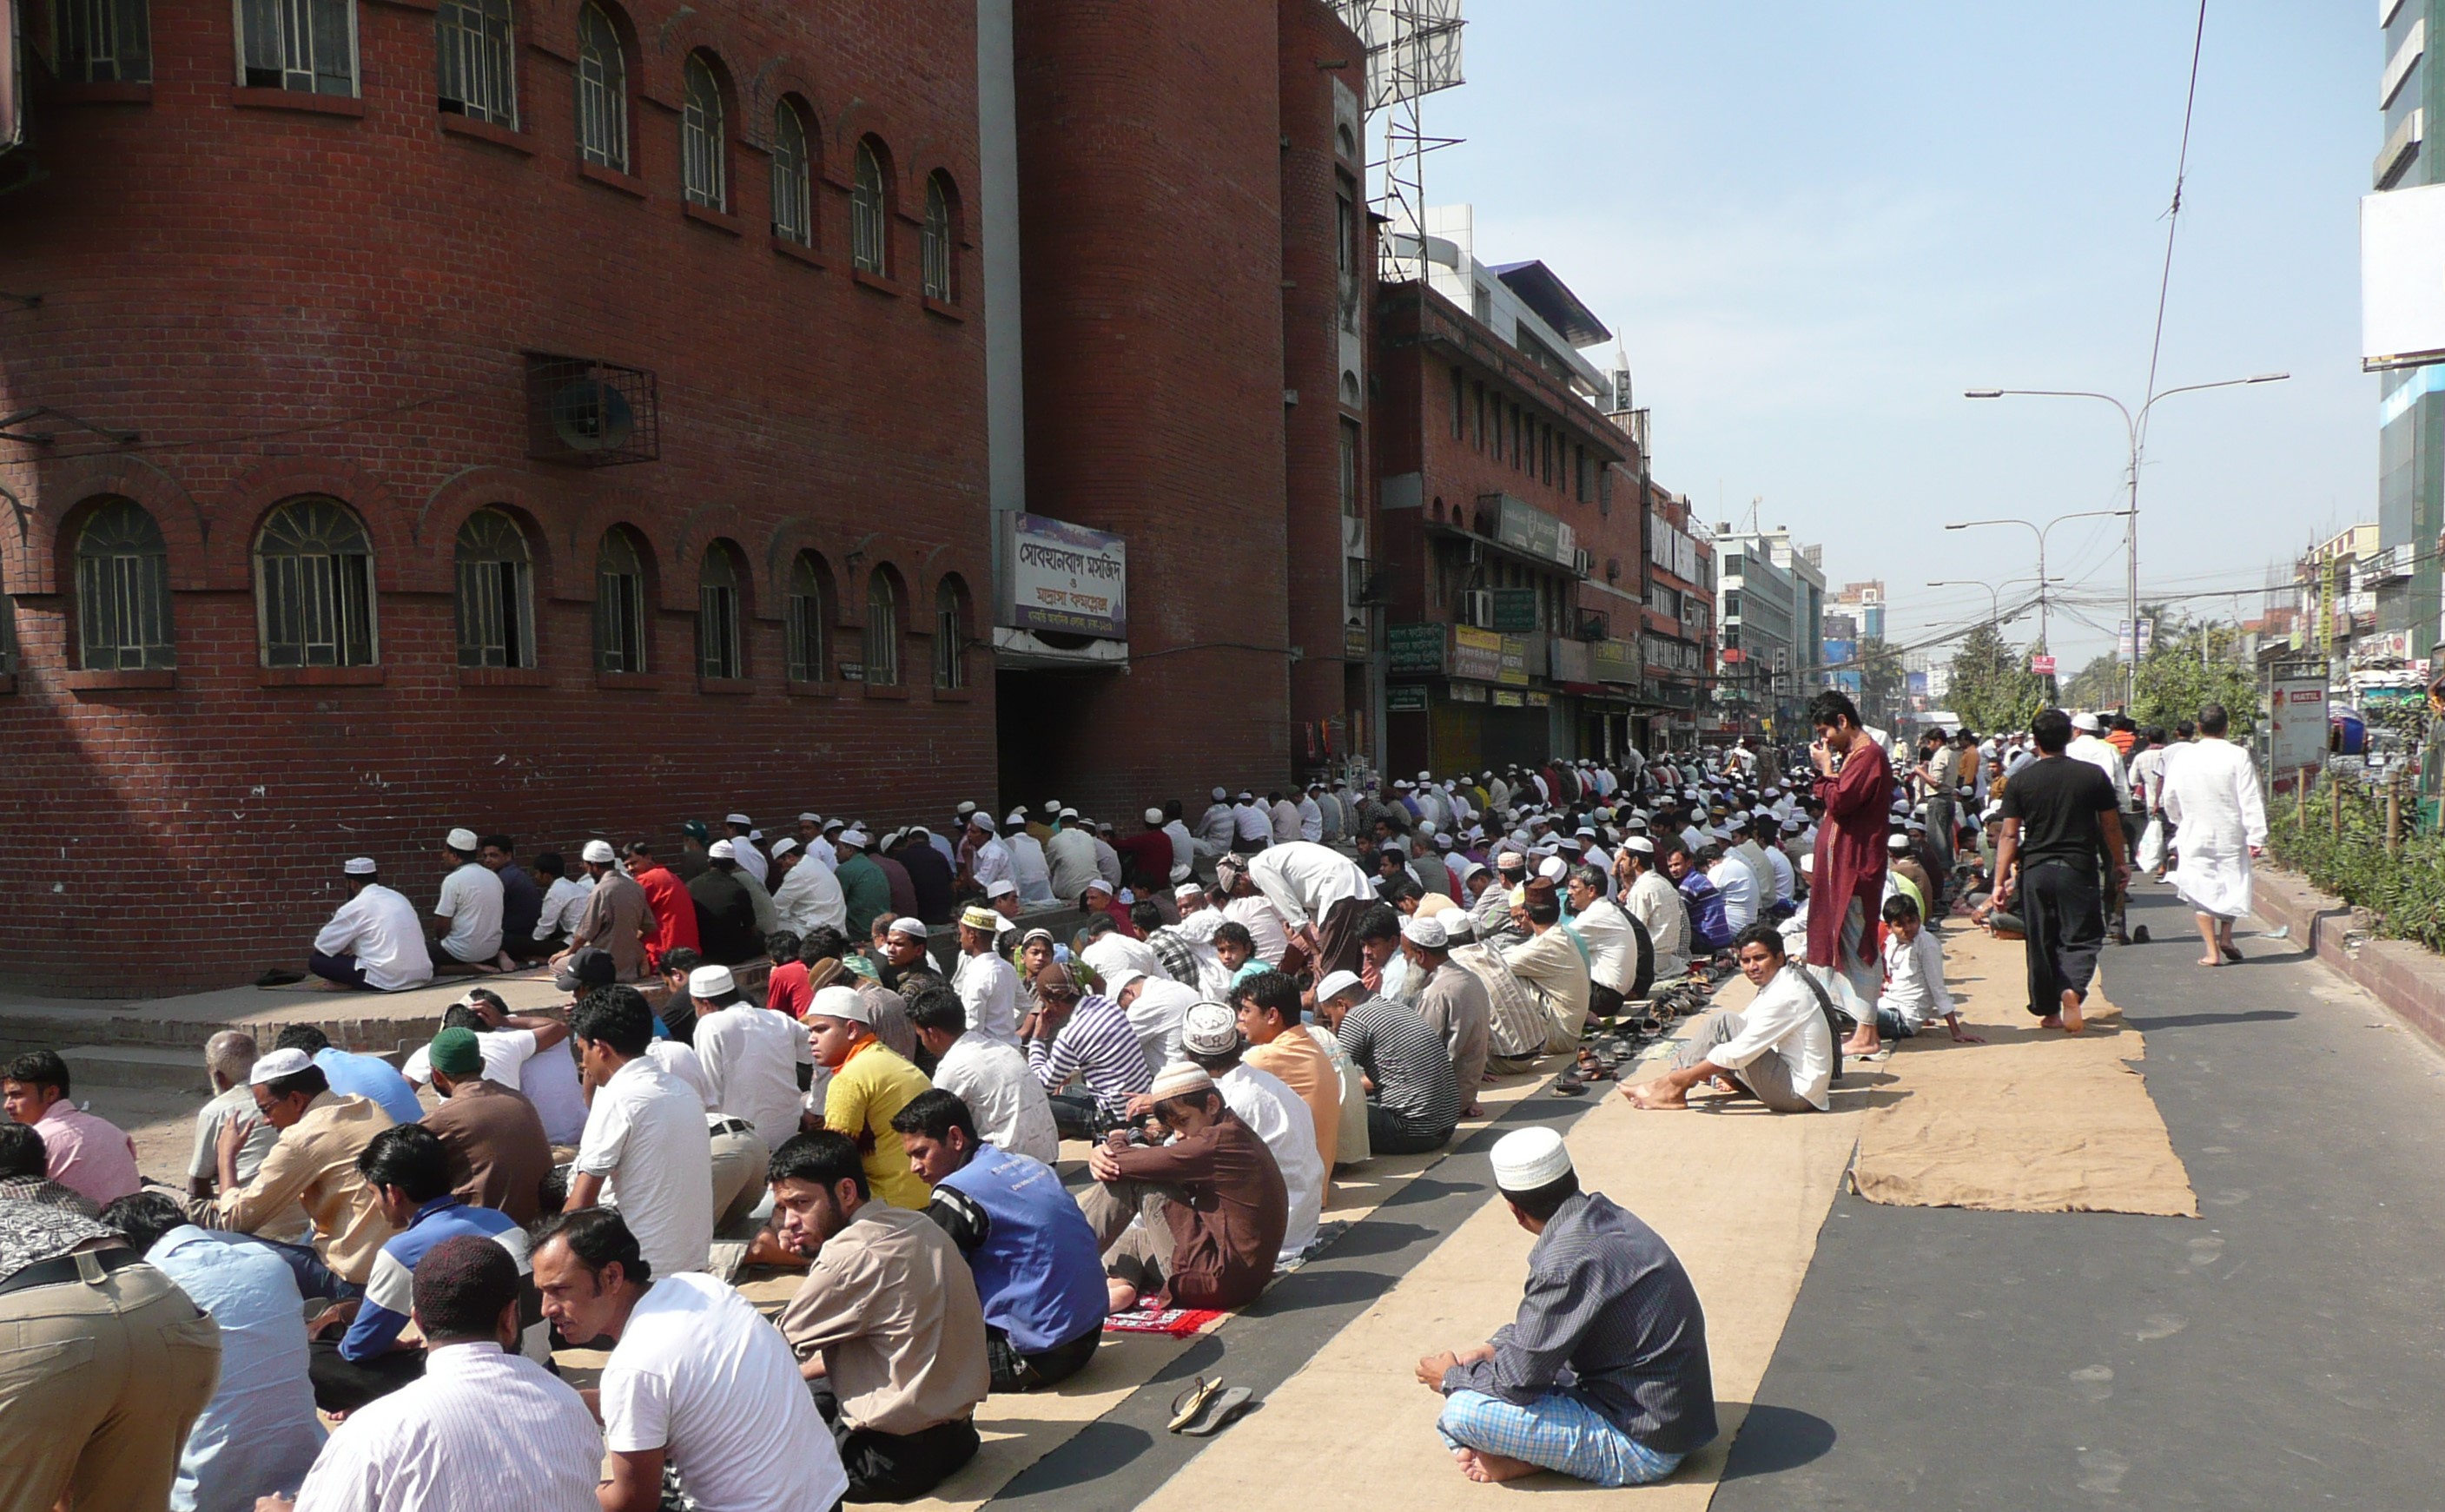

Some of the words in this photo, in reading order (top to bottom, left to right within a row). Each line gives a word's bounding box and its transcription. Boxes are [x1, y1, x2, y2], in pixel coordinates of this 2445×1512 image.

[1020, 542, 1085, 575] সোবহানবাগ
[1087, 552, 1121, 581] মসজিদ
[1069, 578, 1078, 588] ও
[2293, 692, 2319, 701] HATIL
